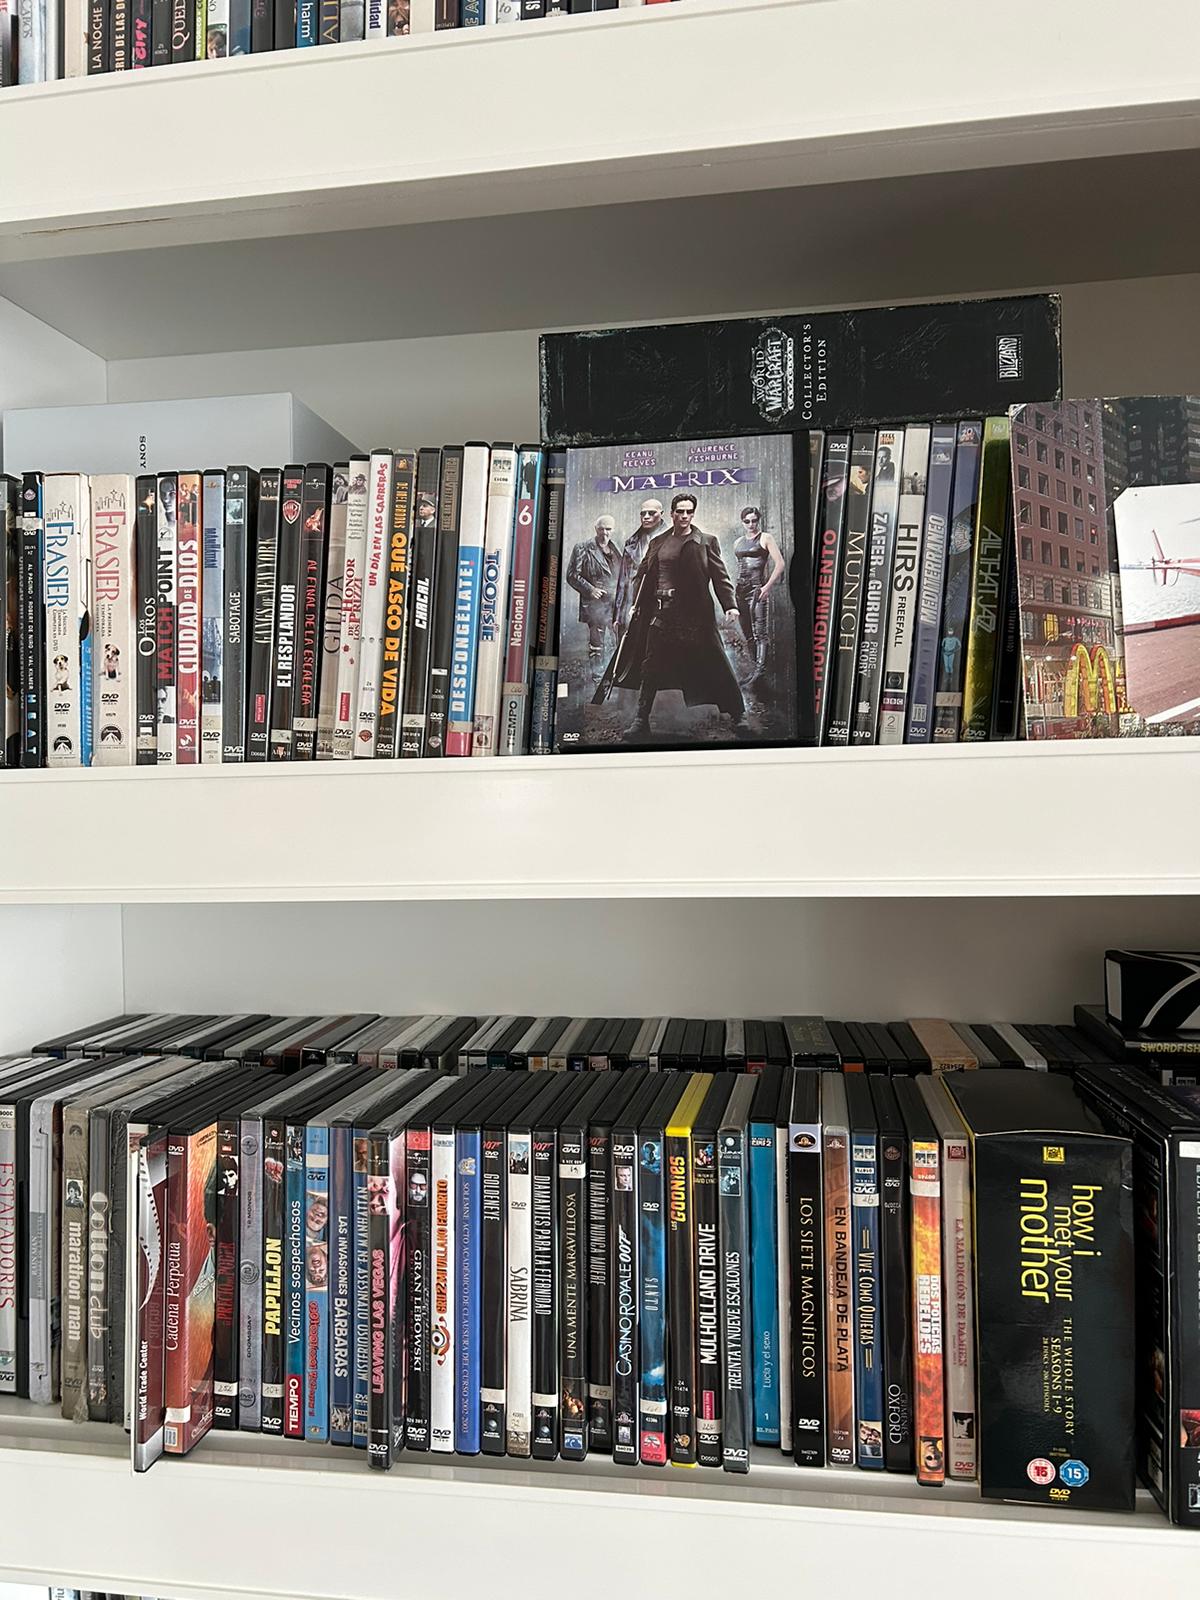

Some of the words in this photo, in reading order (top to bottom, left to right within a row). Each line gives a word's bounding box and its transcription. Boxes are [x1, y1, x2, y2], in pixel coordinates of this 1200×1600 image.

[92, 7, 104, 53] NOCHE
[115, 12, 126, 32] LAS
[115, 34, 126, 47] DE
[92, 57, 103, 69] LA
[756, 351, 765, 400] WORLD
[766, 339, 784, 411] WARCRAFT
[802, 324, 812, 420] COLLECTOR'S
[816, 339, 827, 402] EDITION
[998, 338, 1018, 378] BLIZZARD
[623, 459, 656, 467] REEVES
[625, 450, 654, 458] KEANU
[688, 453, 738, 462] FISHBURNE
[690, 444, 735, 454] LAURENCE
[376, 463, 388, 513] CARRERAS
[612, 467, 741, 494] MATRIX
[375, 516, 383, 534] LAS
[519, 505, 532, 525] 6
[95, 511, 126, 602] FRASIER
[369, 552, 381, 569] DÍA
[374, 537, 381, 550] EN
[391, 532, 409, 572] QUÉ
[870, 513, 888, 566] ZAFER
[893, 523, 919, 592] HIRS
[46, 522, 74, 608] FRASIER
[159, 548, 173, 602] POINT
[179, 539, 197, 588] DIOS
[342, 559, 355, 613] HONOR
[369, 572, 377, 586] UN
[513, 580, 526, 592] III
[869, 567, 876, 578] VE
[184, 589, 192, 599] DE
[386, 578, 403, 630] ASCO
[415, 577, 430, 629] CHACAL
[480, 549, 500, 641] TOOTSIE
[839, 530, 865, 652] MUNICH
[864, 580, 883, 634] GURUR
[180, 602, 197, 673] CIUDAD
[229, 591, 240, 644] SABOTAGE
[278, 585, 295, 670] RESPLANDOR
[323, 576, 344, 654] GILDA
[452, 560, 475, 712] DESCONGÉLATE!
[510, 595, 524, 647] Nacional
[894, 596, 906, 647] FREEFALL
[159, 607, 173, 680] MATCH
[384, 637, 400, 661] DE
[858, 641, 870, 676] GLORY
[277, 674, 291, 687] EL
[380, 667, 398, 716] VIDA
[542, 682, 551, 722] collection
[28, 694, 37, 753] HEAT
[1140, 1042, 1200, 1053] SWORDFISH
[462, 1182, 471, 1220] SOLEMNE
[483, 1173, 500, 1220] GOLDENEYE
[532, 1175, 551, 1226] DIAMANTES
[800, 1197, 814, 1225] LOS
[834, 1207, 847, 1225] EN
[1072, 1185, 1102, 1241] how
[89, 1191, 109, 1292] Cotton
[289, 1201, 301, 1288] sospechosos
[462, 1222, 471, 1244] ACTO
[533, 1228, 551, 1253] PARA
[566, 1192, 575, 1279] MARAVILLOSA
[698, 1223, 717, 1267] DRIVE
[1020, 1178, 1060, 1304] mother
[1053, 1206, 1075, 1248] met
[68, 1221, 86, 1300] marathon
[167, 1241, 180, 1297] Perpetua
[413, 1250, 422, 1294] GRAN
[462, 1246, 473, 1294] ACADÉMICO
[535, 1254, 551, 1265] LA
[800, 1230, 814, 1271] SIETE
[835, 1231, 848, 1299] BANDEJA
[858, 1252, 875, 1274] VIVE
[265, 1238, 281, 1335] PAPILLON
[372, 1249, 385, 1298] VEGAS
[509, 1266, 528, 1323] SABRINA
[535, 1268, 552, 1315] ETERNIDAD
[644, 1277, 659, 1312] SANTO
[859, 1276, 876, 1302] COMO
[930, 1276, 940, 1298] DOS
[1048, 1255, 1073, 1301] your
[68, 1304, 83, 1341] man
[90, 1295, 108, 1339] club
[289, 1292, 300, 1344] Vecinos
[372, 1300, 385, 1329] LAS
[462, 1296, 470, 1306] DE
[566, 1283, 576, 1328] MENTE
[697, 1269, 717, 1364] MULHOLLAND
[836, 1303, 848, 1323] DE
[918, 1276, 931, 1355] REBELDES
[166, 1303, 179, 1350] Cadena
[413, 1297, 422, 1372] LEBOWSKI
[462, 1308, 470, 1350] CLAUSURA
[567, 1329, 576, 1359] UNA
[801, 1276, 818, 1378] MAGNÍFICOS
[857, 1305, 876, 1346] QUIERAS
[930, 1300, 941, 1354] POLICIAS
[1063, 1318, 1072, 1341] THE
[140, 1340, 149, 1367] Center
[372, 1331, 385, 1394] LEAVING
[462, 1350, 470, 1365] DEL
[763, 1351, 771, 1359] el
[836, 1327, 848, 1372] PLATA
[1050, 1337, 1062, 1390] SEASONS
[1064, 1347, 1073, 1391] WHOLE
[139, 1370, 148, 1395] Trade
[763, 1368, 771, 1388] Lucía
[138, 1397, 148, 1420] World
[289, 1378, 299, 1431] TIEMPO
[887, 1384, 901, 1444] OXFORD
[1052, 1395, 1062, 1414] 1-9
[1064, 1396, 1074, 1436] STORY
[1067, 1468, 1082, 1478] 15
